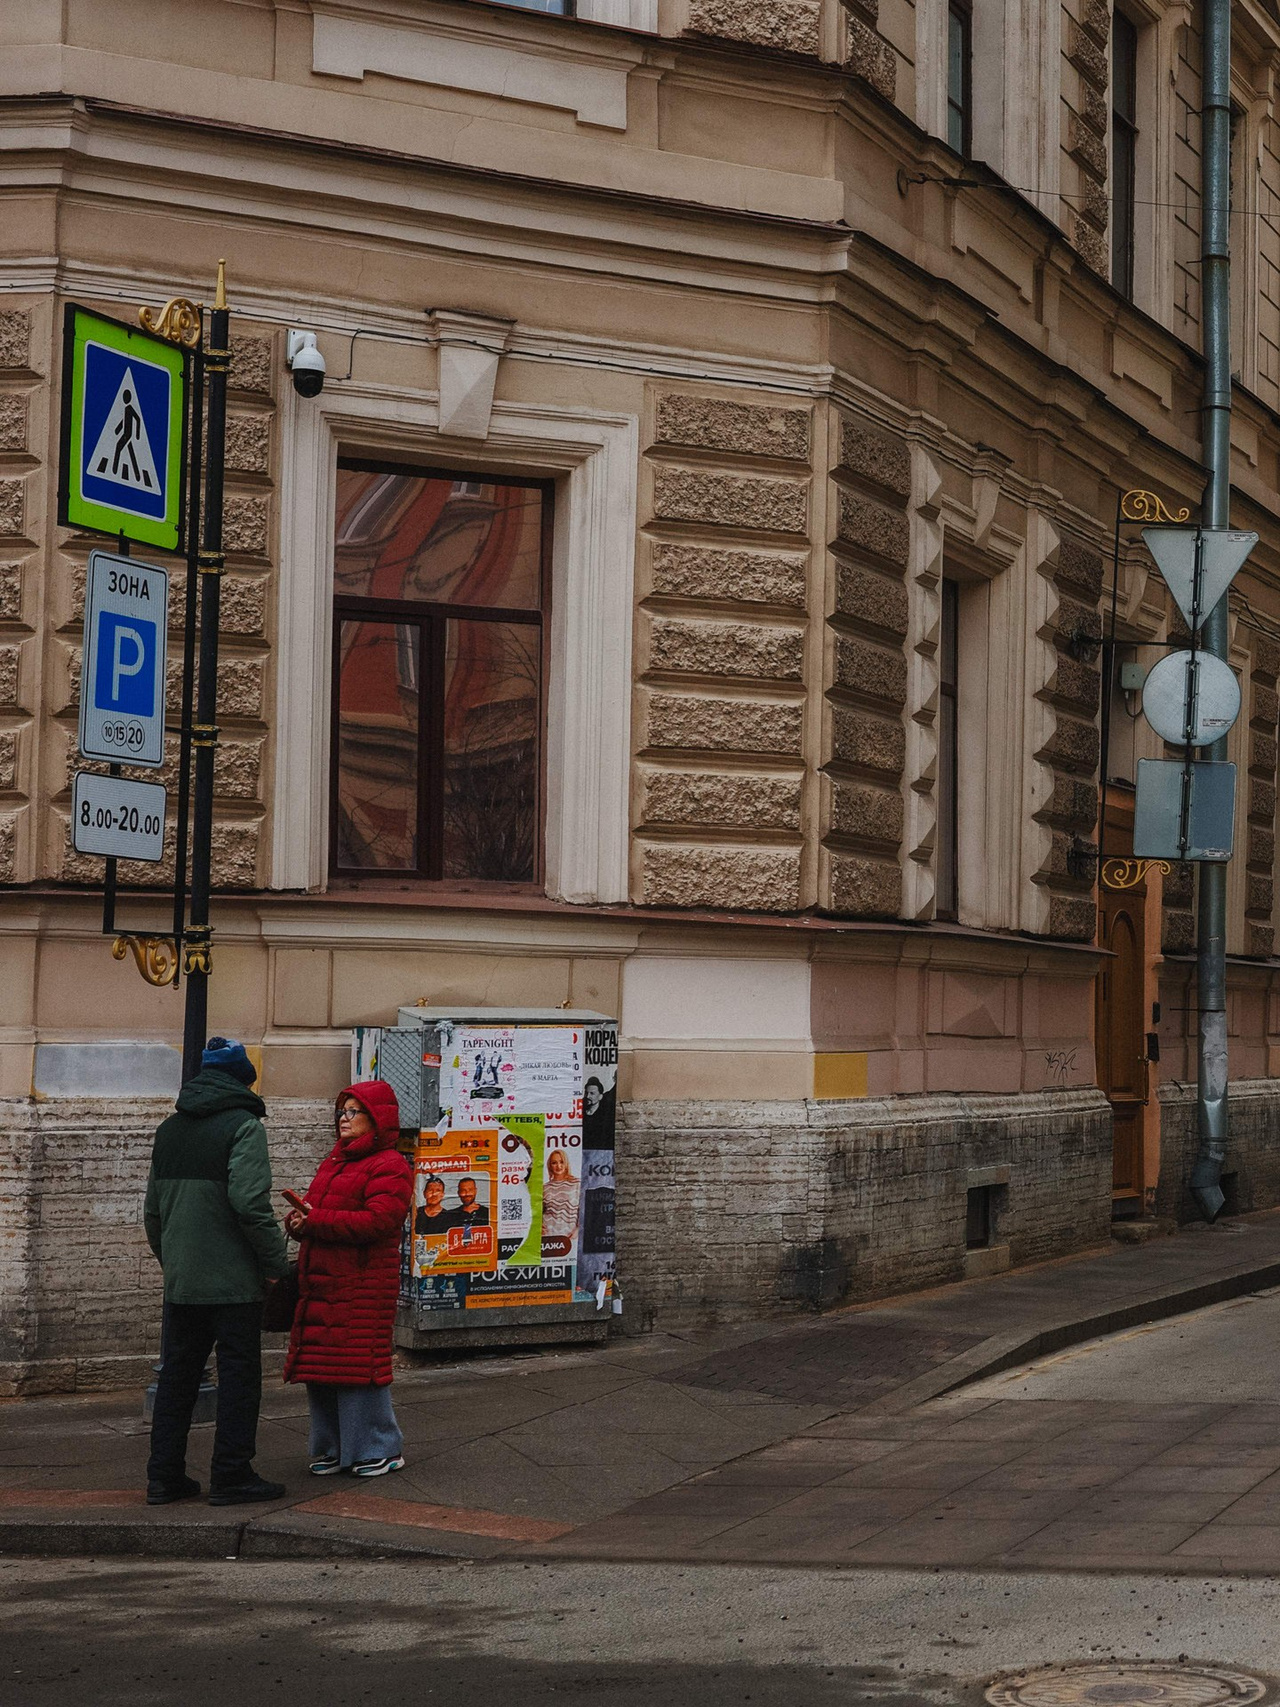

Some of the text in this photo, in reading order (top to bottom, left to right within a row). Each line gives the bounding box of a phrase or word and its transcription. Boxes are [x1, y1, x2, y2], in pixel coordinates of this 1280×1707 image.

[109, 571, 150, 600] ЗОНА
[112, 625, 145, 701] P
[104, 724, 142, 746] 10 15 20
[80, 800, 160, 836] 8.00-20.00
[462, 1039, 514, 1048] TAPENIGHT
[515, 1116, 542, 1124] ТЕБЯ,
[470, 1265, 566, 1282] РОК-ХИТЫ
